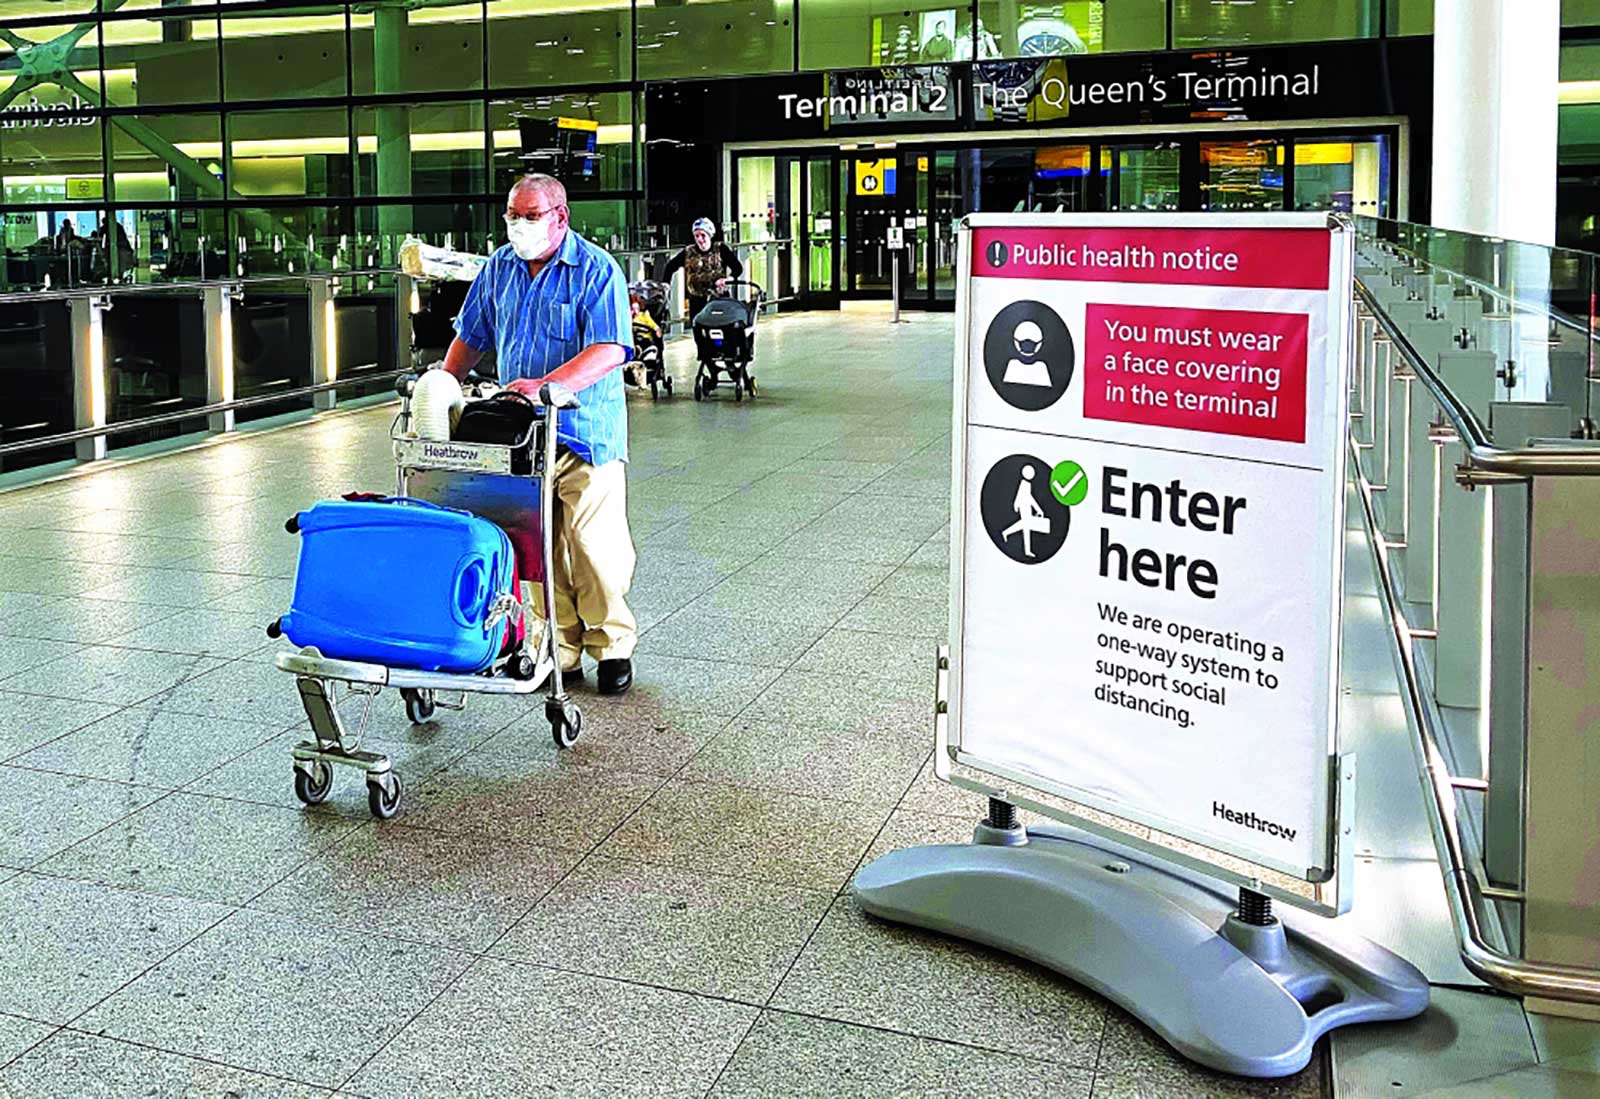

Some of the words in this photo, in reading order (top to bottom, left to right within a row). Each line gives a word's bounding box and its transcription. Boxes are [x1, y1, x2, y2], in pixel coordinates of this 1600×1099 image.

[778, 84, 917, 119] Terminal
[929, 85, 948, 112] 2
[972, 82, 1028, 108] The
[1041, 75, 1167, 110] Queen's
[1177, 64, 1319, 100] Terminal
[1013, 244, 1076, 268] Public
[1082, 246, 1155, 269] health
[1163, 248, 1239, 271] notice
[1104, 319, 1149, 343] You
[1154, 325, 1212, 347] must
[1218, 331, 1283, 352] wear
[1104, 353, 1117, 371] a
[1122, 352, 1169, 376] face
[1175, 357, 1281, 391] covering
[1106, 380, 1125, 402] in
[1131, 382, 1168, 408] the
[1174, 389, 1278, 419] terminal
[424, 445, 479, 460] Heathrow
[1101, 465, 1247, 535] Enter
[1099, 527, 1218, 599] here
[1097, 602, 1128, 626] We
[1132, 615, 1162, 634] are
[1167, 622, 1266, 662] operating
[1272, 646, 1284, 662] a
[1096, 659, 1167, 690] support
[1172, 679, 1226, 706] social
[1097, 633, 1177, 668] one-way
[1181, 653, 1250, 683] system
[1256, 668, 1279, 689] to
[1094, 684, 1195, 729] distancing.
[1212, 800, 1297, 842] Heathrow
